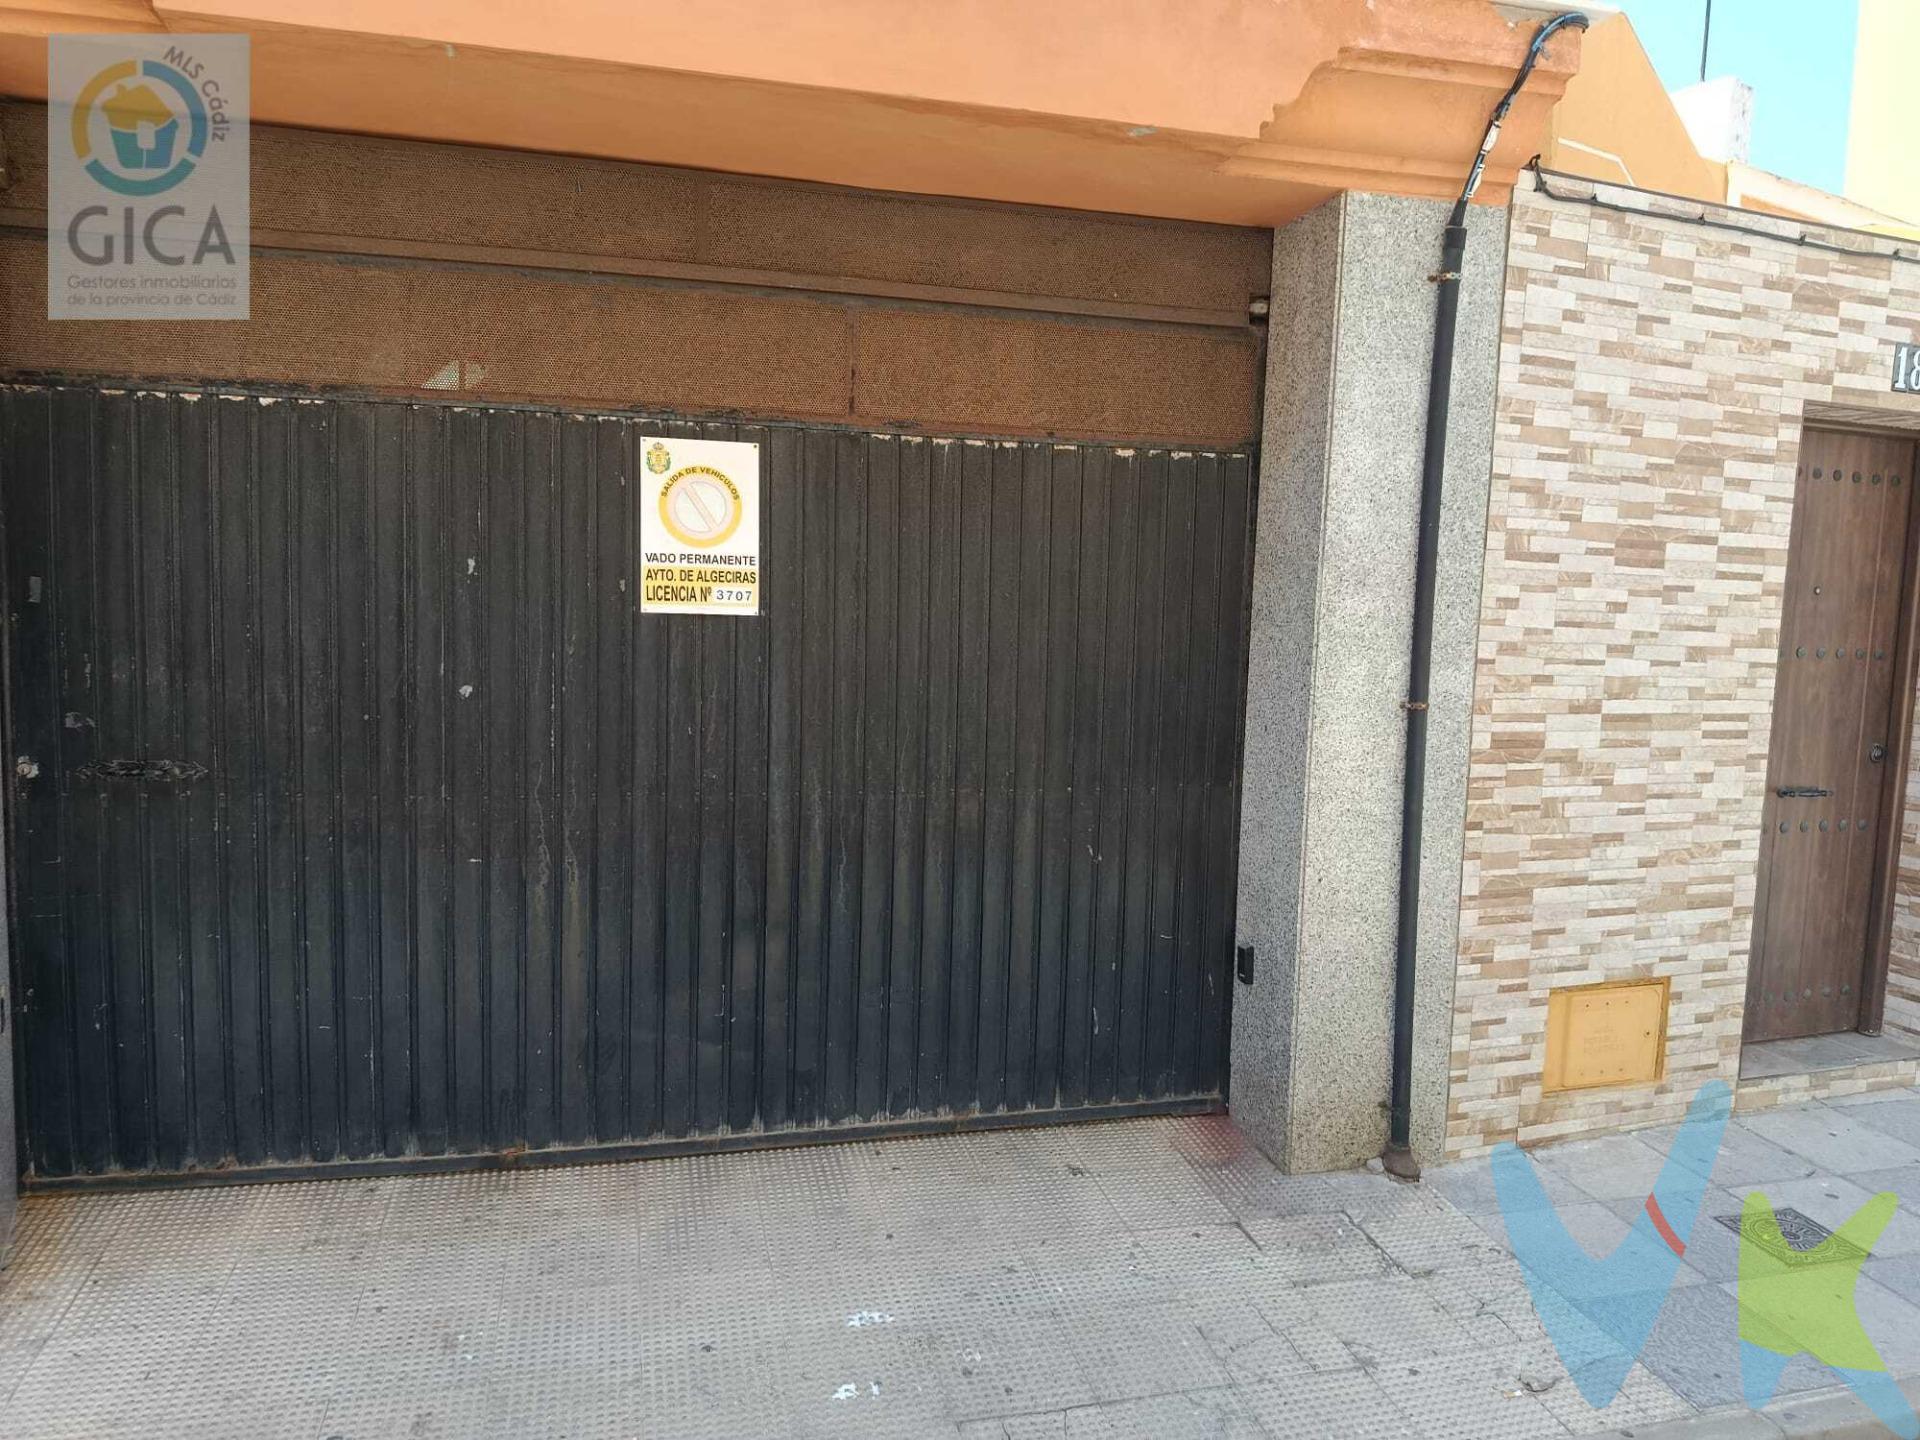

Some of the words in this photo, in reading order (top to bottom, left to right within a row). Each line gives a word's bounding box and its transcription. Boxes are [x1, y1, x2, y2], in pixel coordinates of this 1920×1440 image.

[661, 471, 684, 497] SALIDA
[700, 466, 740, 500] VEHICULOS
[645, 553, 676, 563] VADO
[679, 554, 756, 566] PERMANENTE
[646, 569, 677, 582] AYTO.
[680, 569, 694, 582] DE
[696, 570, 757, 584] ALGECIRAS
[646, 585, 697, 602] LICENCIA
[700, 586, 712, 602] Nº
[716, 590, 752, 601] 3707
